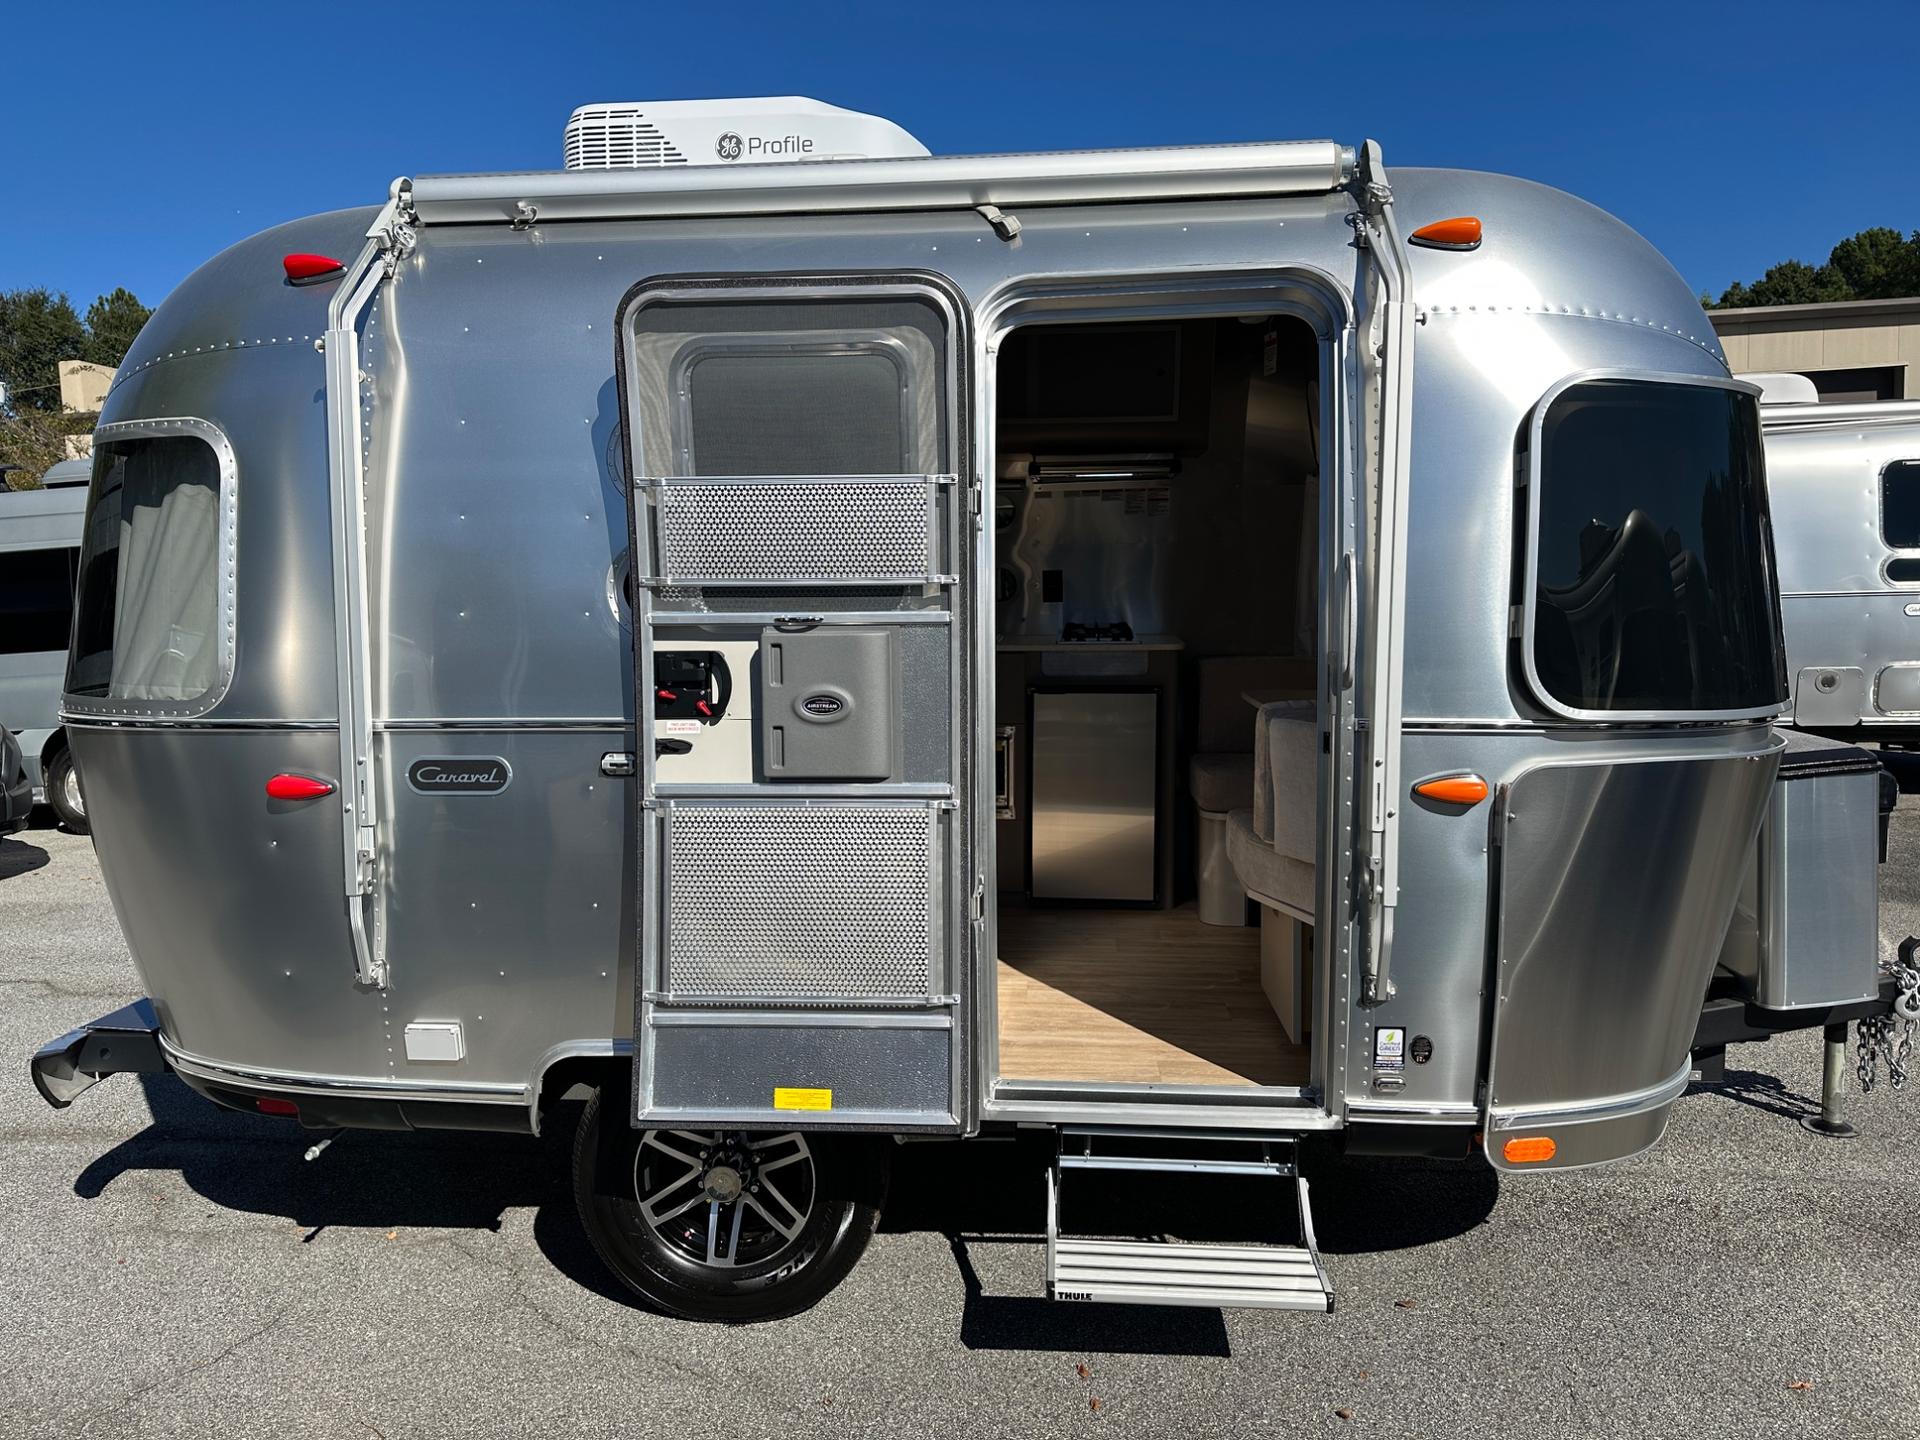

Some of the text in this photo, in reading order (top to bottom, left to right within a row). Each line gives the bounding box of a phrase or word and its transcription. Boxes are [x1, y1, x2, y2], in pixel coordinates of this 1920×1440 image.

[748, 136, 813, 155] Profile
[416, 766, 501, 783] Caravel
[1057, 1291, 1093, 1301] THULE
